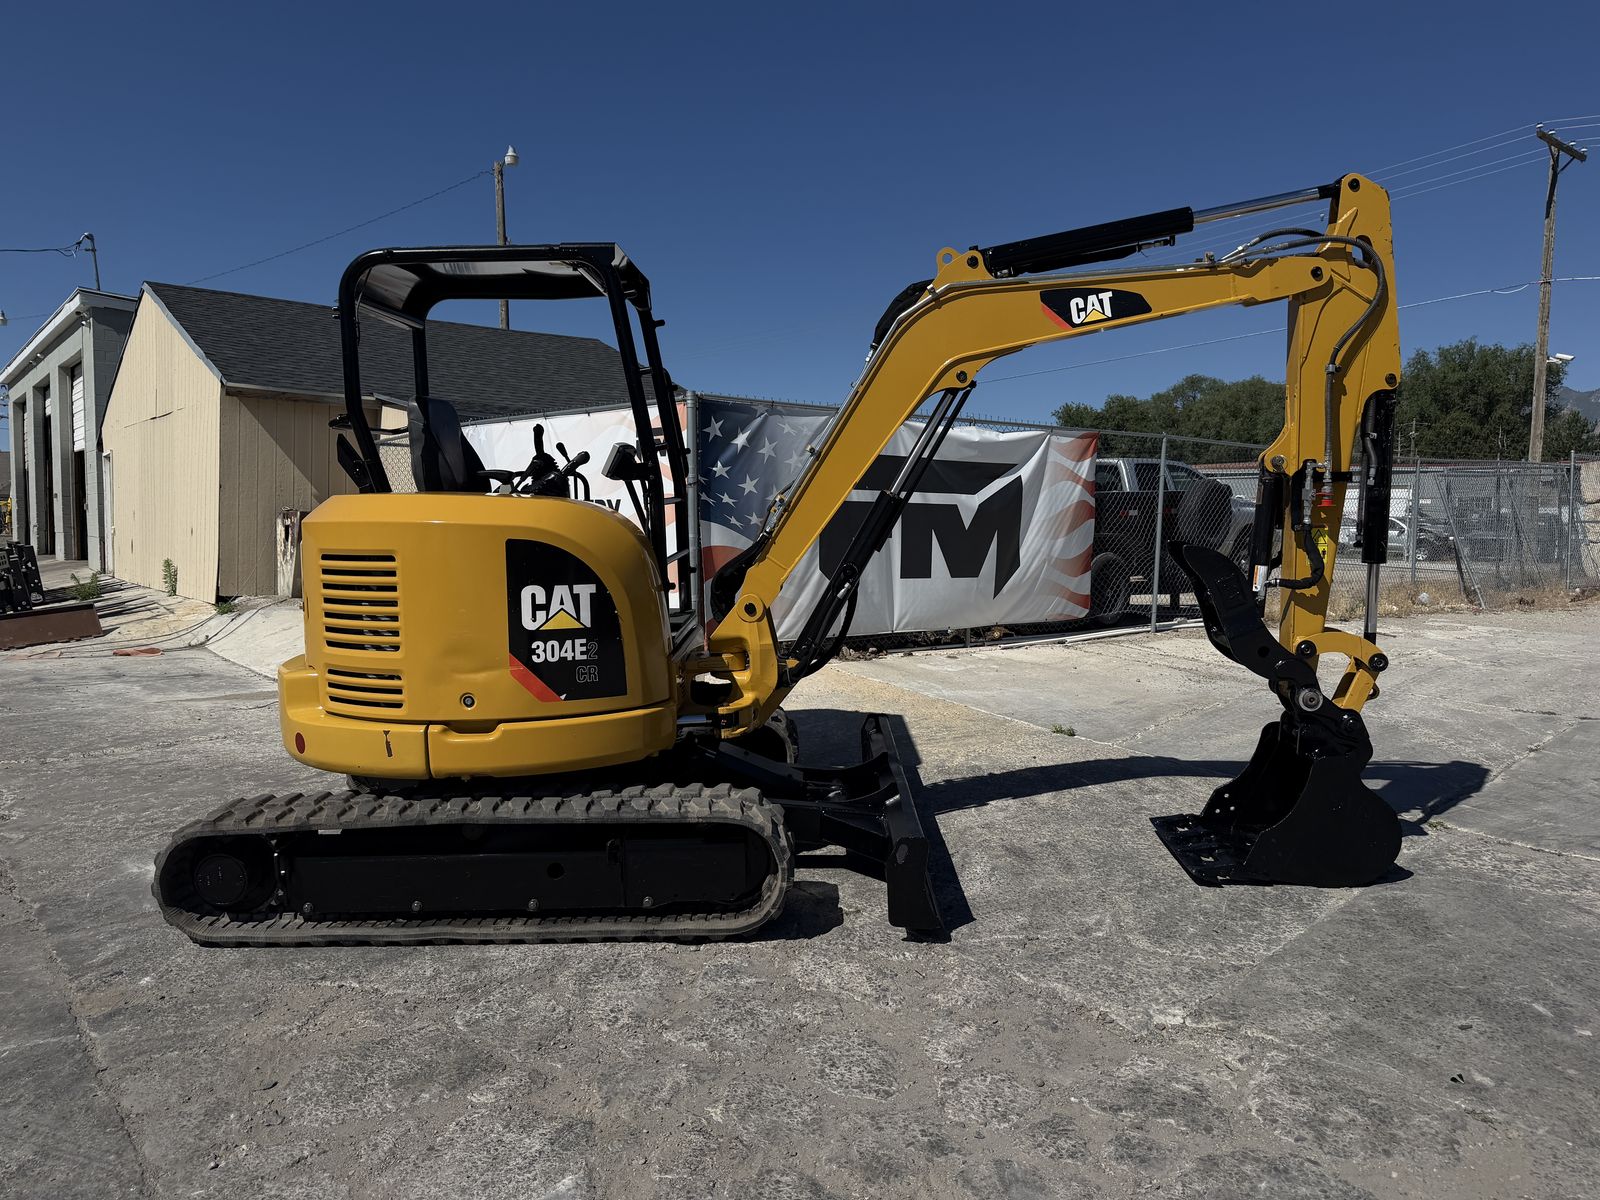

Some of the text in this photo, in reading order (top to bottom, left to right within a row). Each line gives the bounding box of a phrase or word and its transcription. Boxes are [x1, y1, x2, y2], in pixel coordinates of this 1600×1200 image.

[1069, 291, 1113, 325] CAT
[520, 583, 597, 631] CAT
[531, 638, 598, 663] 304E2
[575, 665, 599, 683] CR
